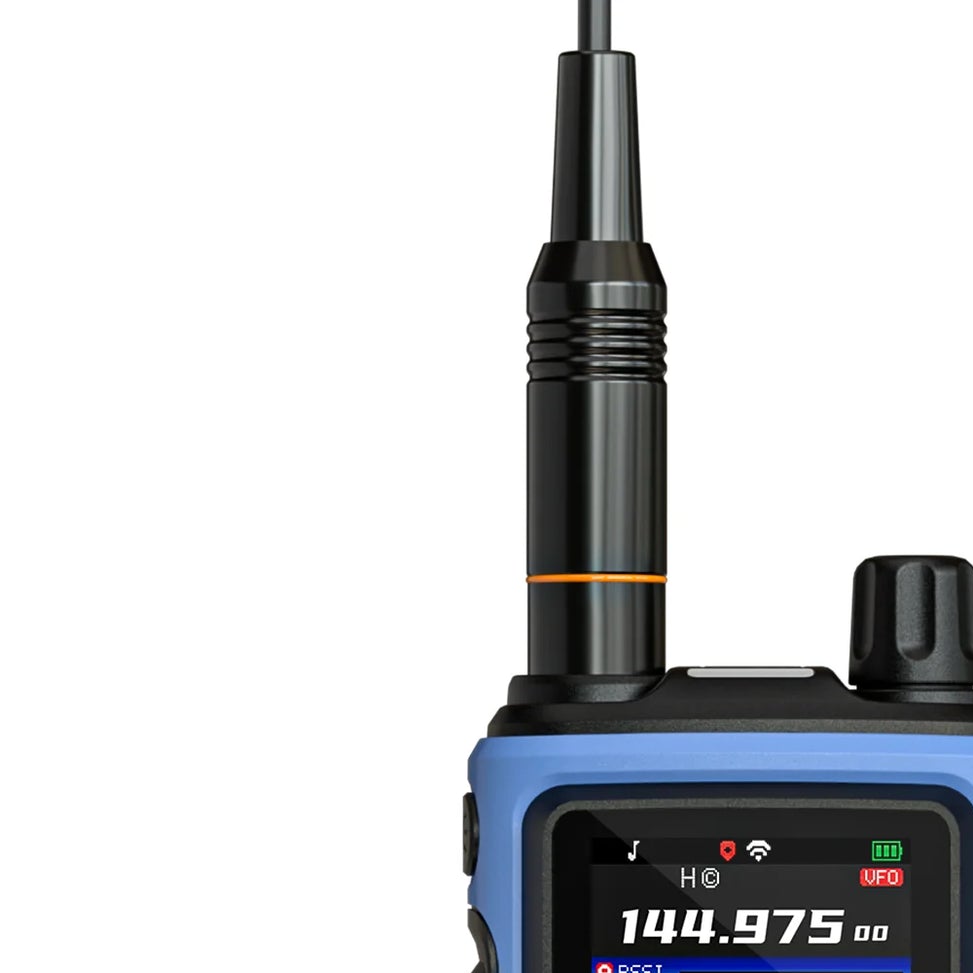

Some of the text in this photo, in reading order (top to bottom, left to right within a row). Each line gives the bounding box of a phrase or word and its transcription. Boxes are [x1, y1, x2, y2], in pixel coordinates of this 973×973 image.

[681, 868, 695, 888] H
[865, 870, 900, 886] VFO
[622, 909, 844, 944] 144.975
